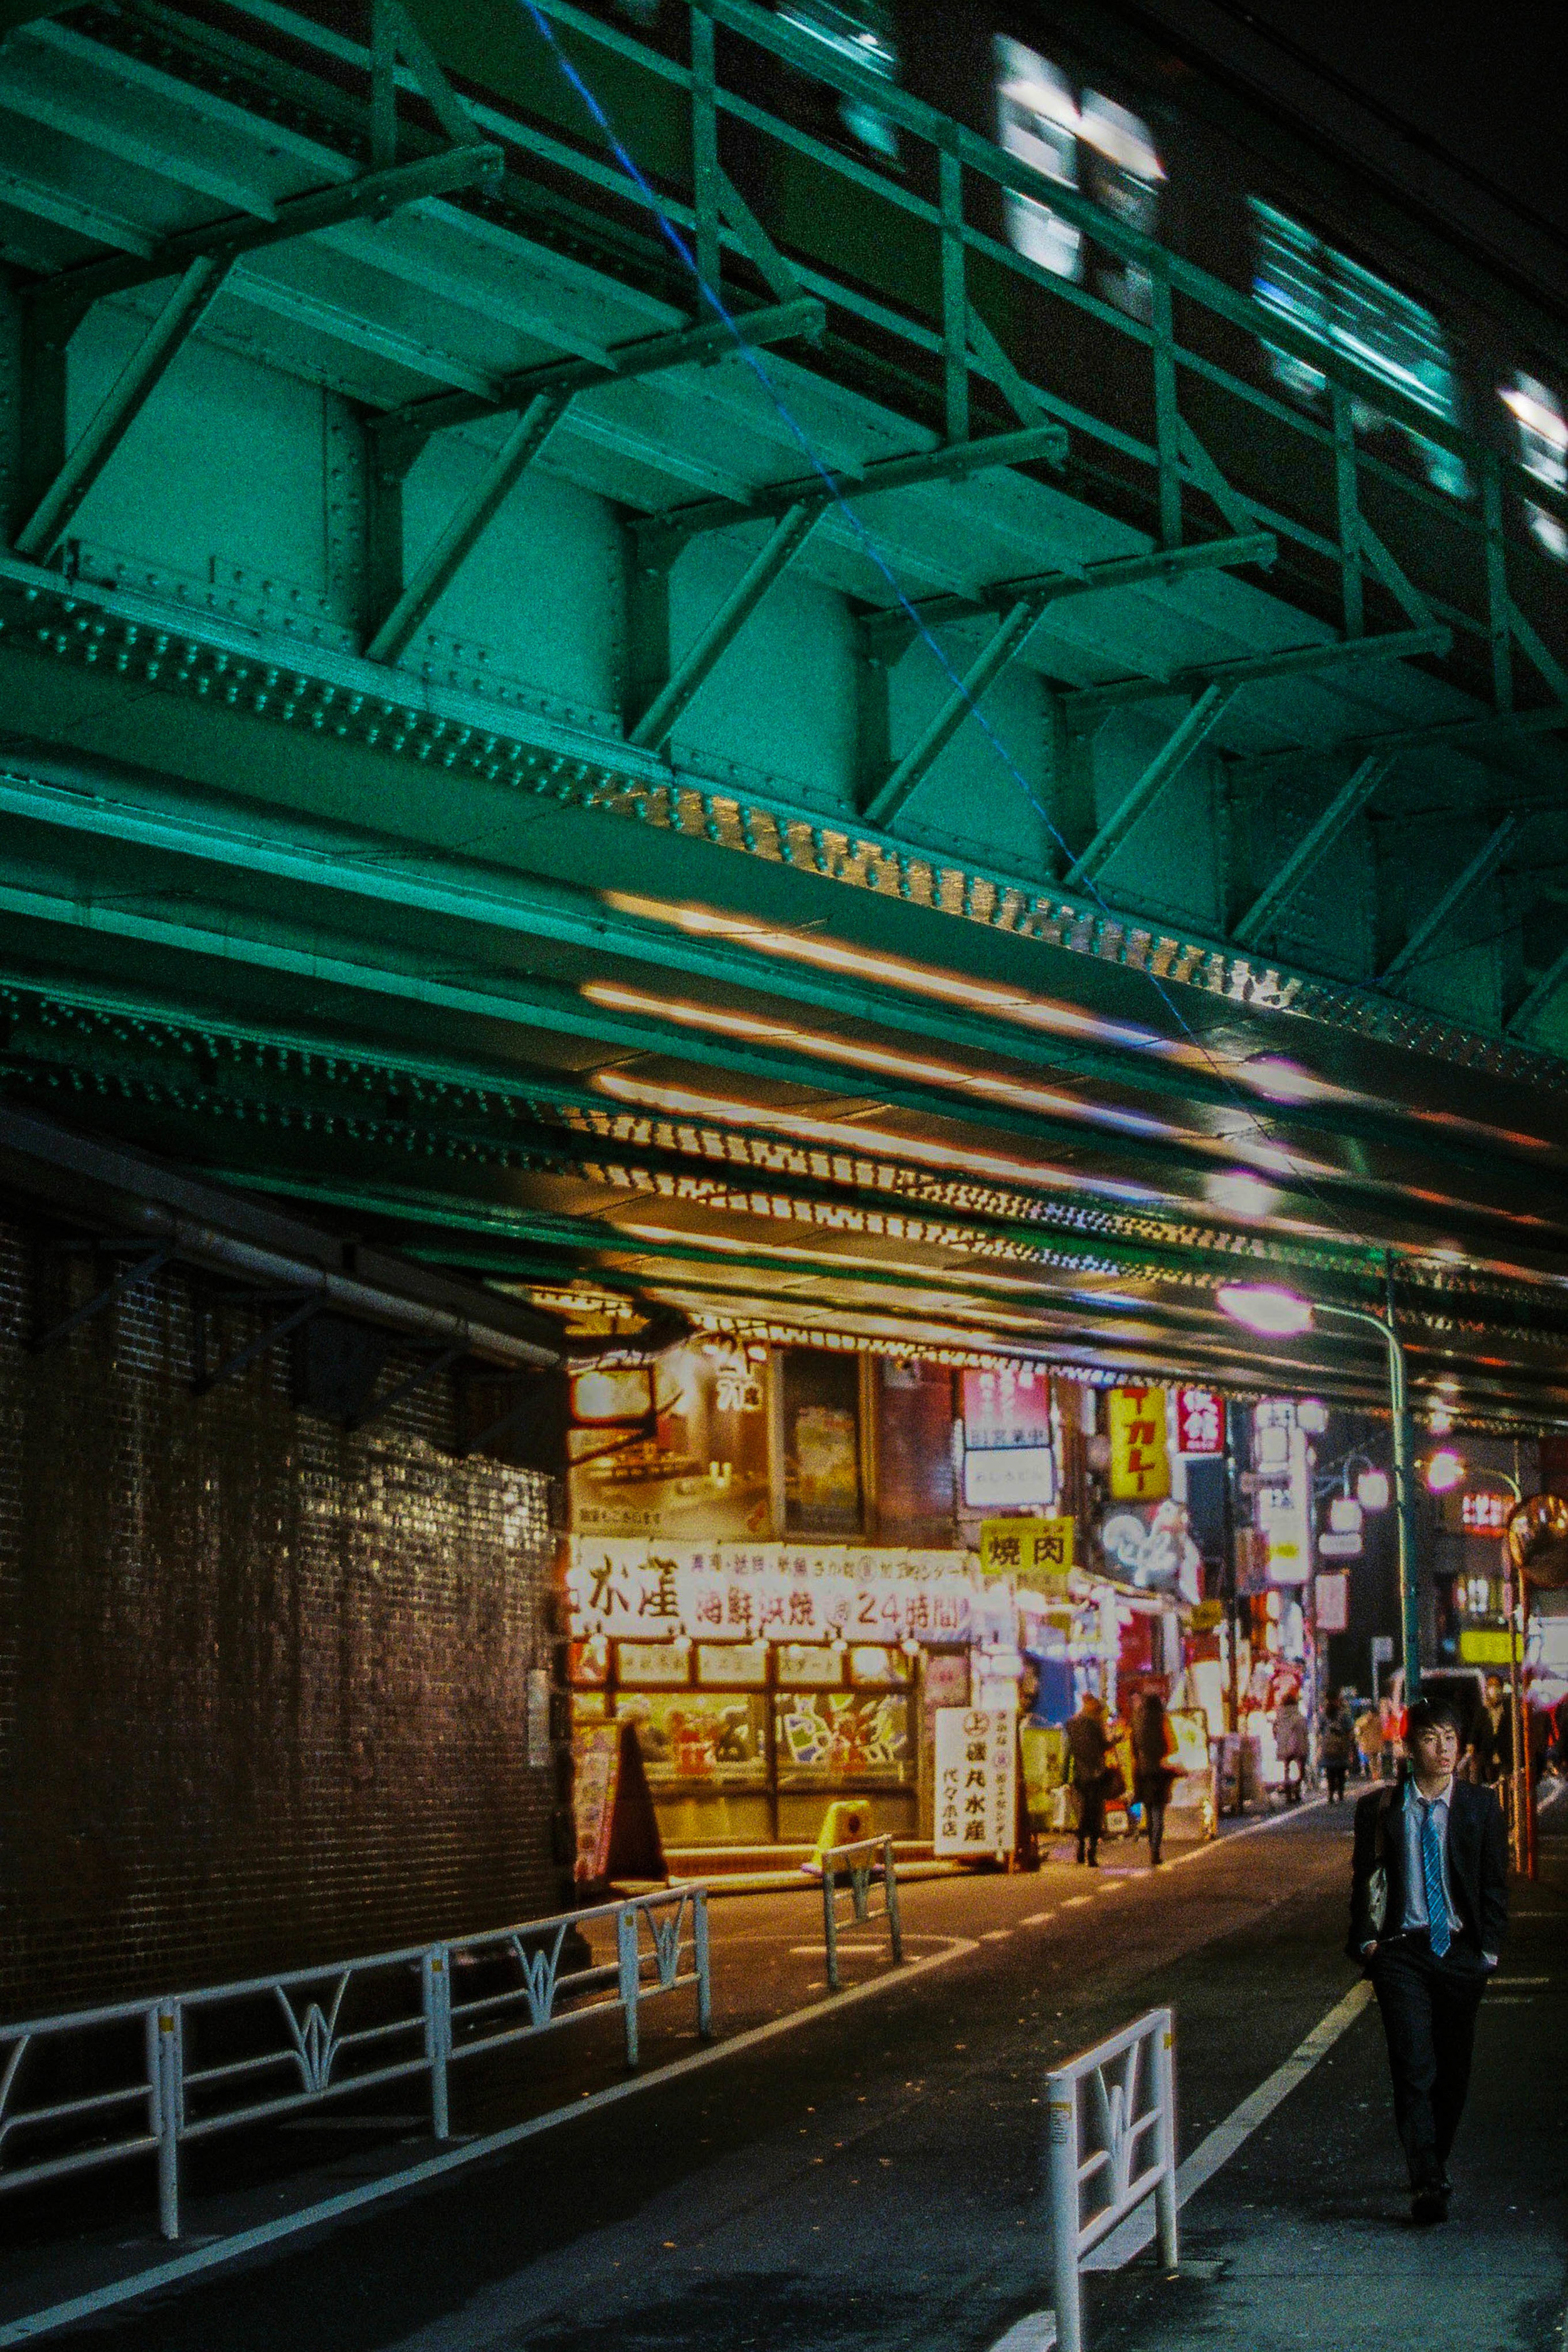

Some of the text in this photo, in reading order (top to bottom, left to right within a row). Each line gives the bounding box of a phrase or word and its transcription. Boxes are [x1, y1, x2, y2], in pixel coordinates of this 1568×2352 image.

[988, 1535, 1064, 1565] 焼肉
[569, 1552, 680, 1617] 水産
[856, 1590, 958, 1629] 24時間
